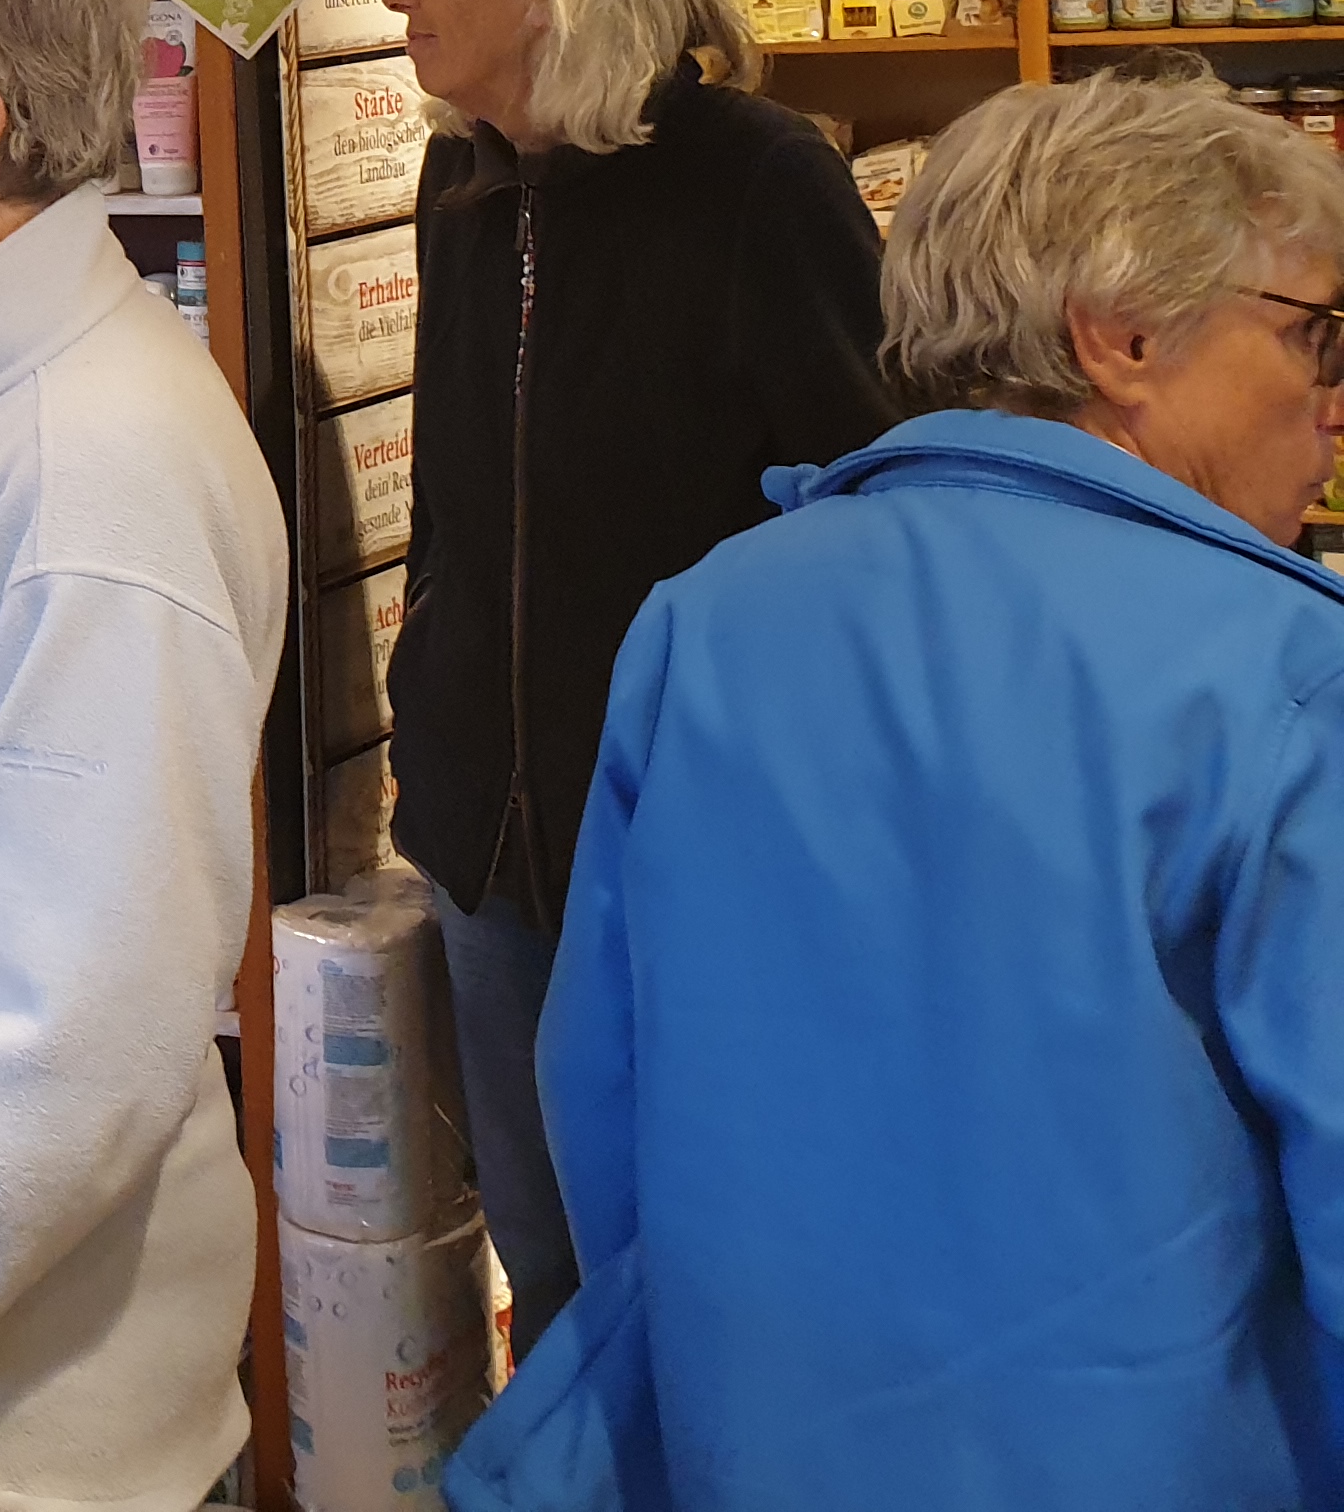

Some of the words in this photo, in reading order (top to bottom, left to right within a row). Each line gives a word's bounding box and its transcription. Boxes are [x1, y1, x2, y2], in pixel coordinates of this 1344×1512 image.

[150, 13, 182, 22] GONA
[354, 87, 403, 120] Stärke
[334, 134, 356, 156] den
[358, 121, 426, 154] biologischen
[359, 158, 406, 185] Landbau
[358, 272, 413, 310] Erhalte
[358, 320, 376, 342] die
[354, 428, 414, 473] Verteidi
[365, 476, 389, 502] dein
[374, 596, 403, 632] Ach
